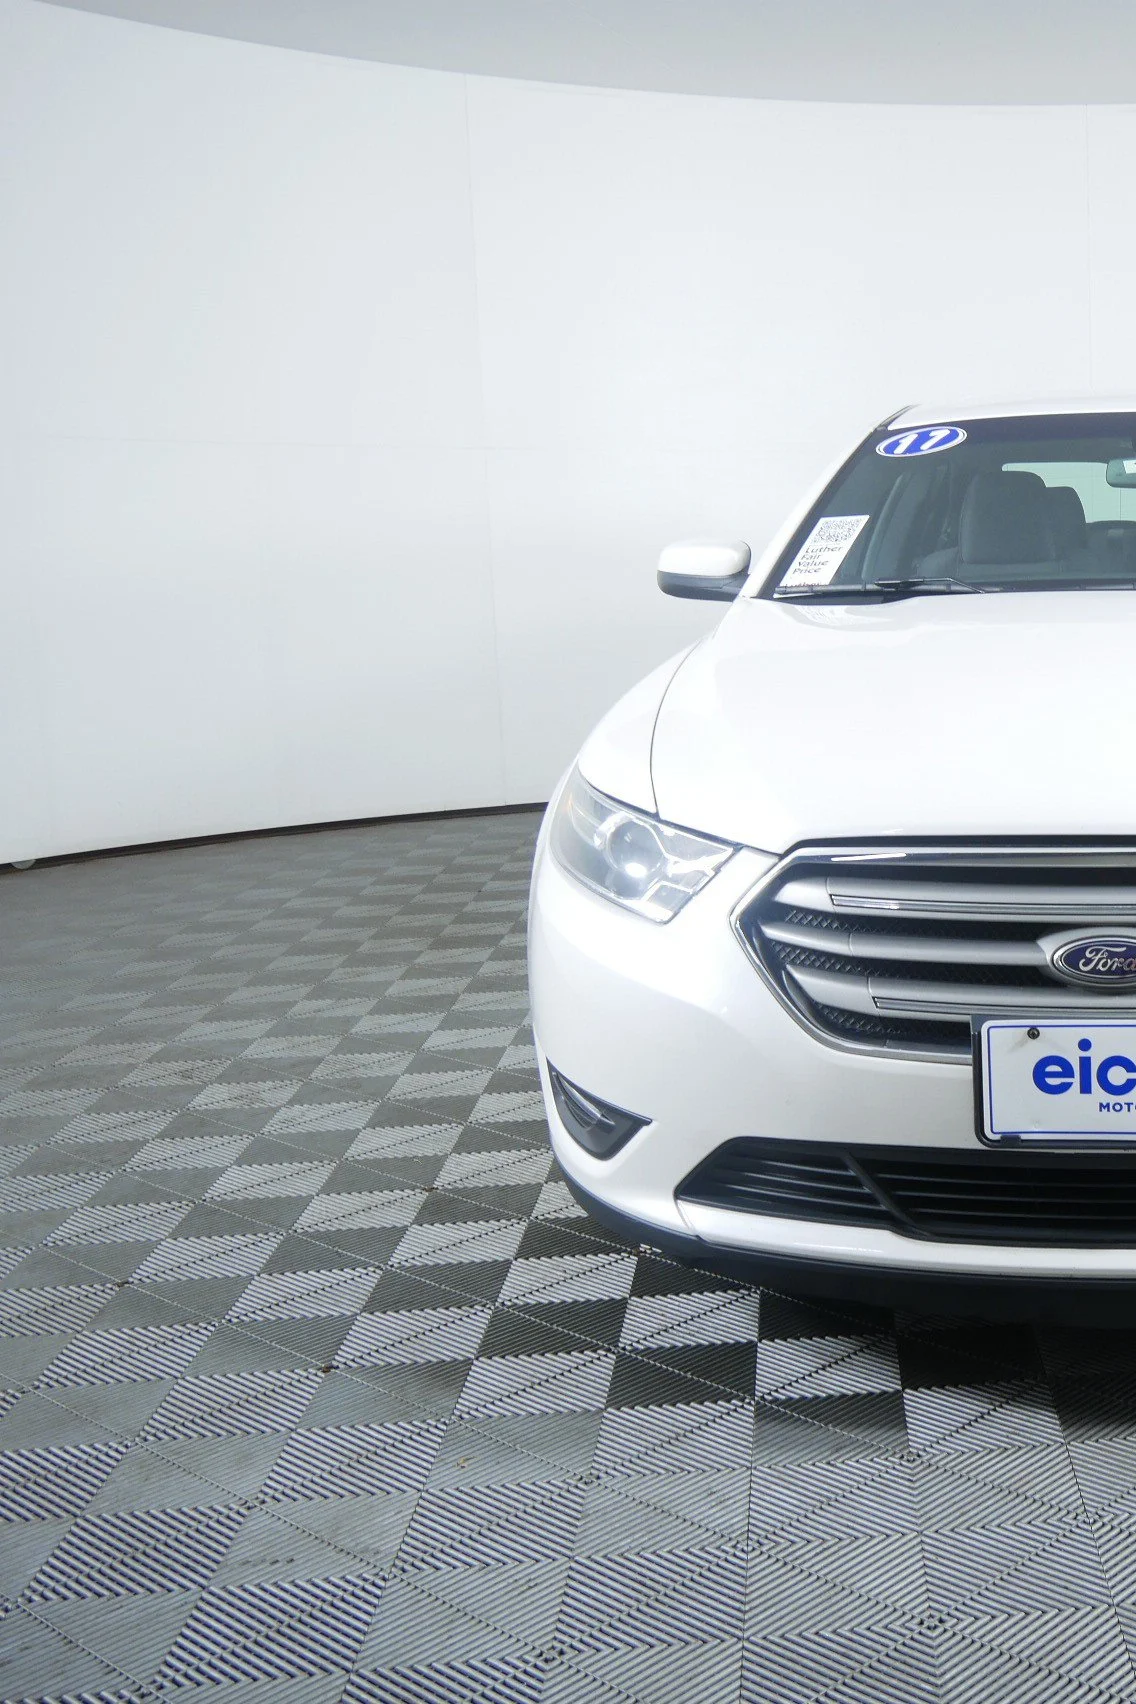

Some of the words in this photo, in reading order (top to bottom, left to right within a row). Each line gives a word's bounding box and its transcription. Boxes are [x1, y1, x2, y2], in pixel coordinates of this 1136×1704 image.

[893, 428, 951, 454] 17
[805, 545, 844, 554] Luther
[792, 567, 821, 575] Price
